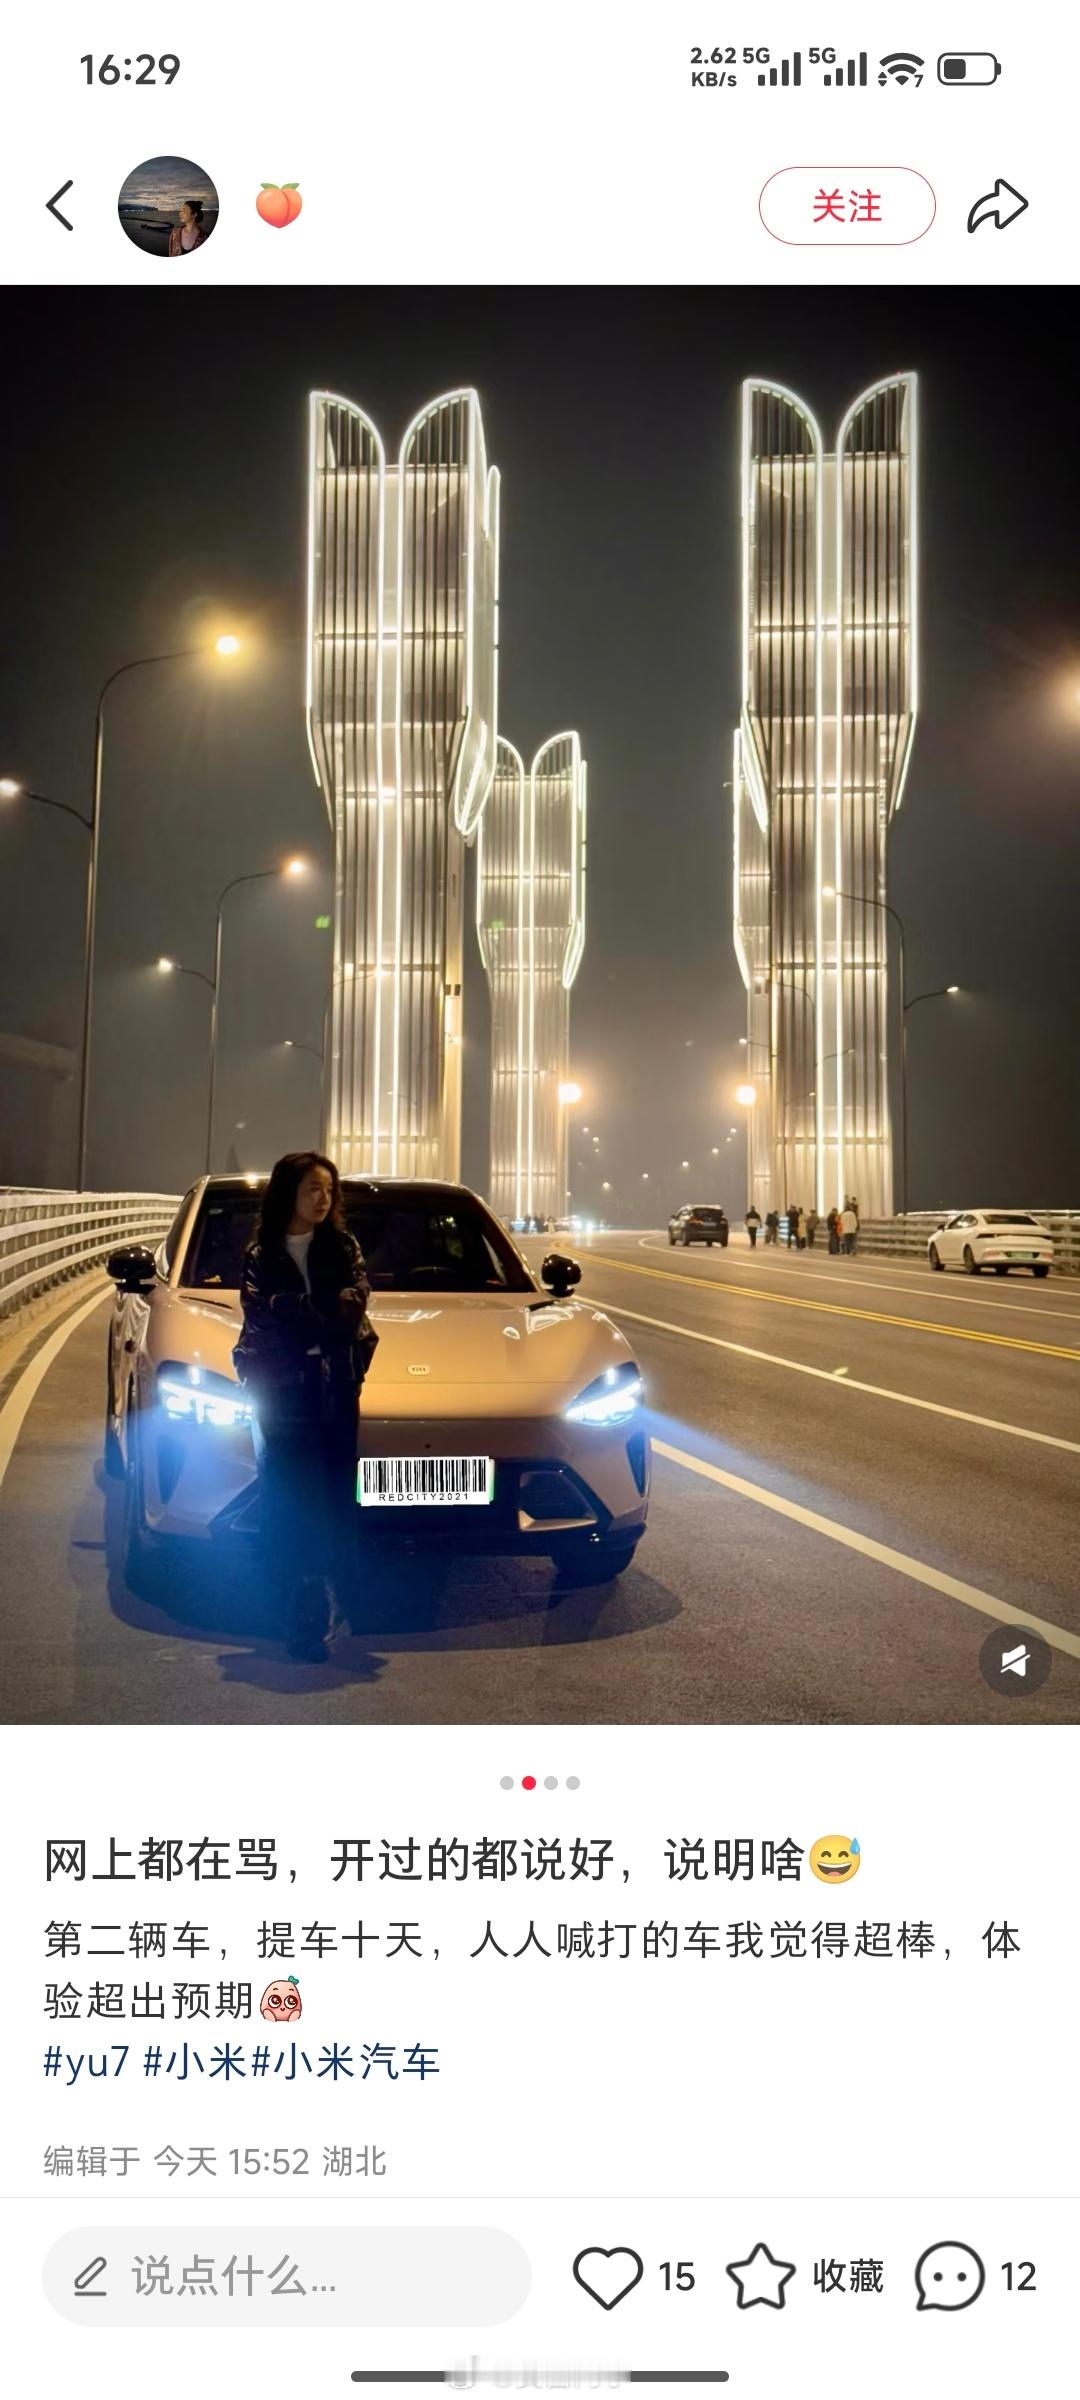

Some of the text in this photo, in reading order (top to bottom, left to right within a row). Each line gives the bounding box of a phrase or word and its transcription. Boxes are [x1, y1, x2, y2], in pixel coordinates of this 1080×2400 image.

[81, 54, 180, 85] 16:29
[691, 47, 736, 64] 2.62
[743, 47, 770, 64] 5G
[809, 47, 836, 64] 5G
[692, 72, 738, 87] KB/s
[914, 75, 924, 88] 7
[814, 189, 882, 222] 关注
[46, 1837, 805, 1883] 网上都在骂，开过的都说好，说明啥
[44, 1920, 1020, 1960] 第二辆车，提车十天，人人喊打的车我觉得超棒，体
[44, 1981, 251, 2019] 验超出预期
[44, 2042, 440, 2086] #yu7 #小米#小米汽车
[44, 2145, 386, 2176] 编辑于 今天 15:52 湖北
[132, 2255, 335, 2296] 说点什么...
[659, 2262, 695, 2291] 15
[814, 2258, 883, 2293] 收藏
[1002, 2262, 1036, 2290] 12
